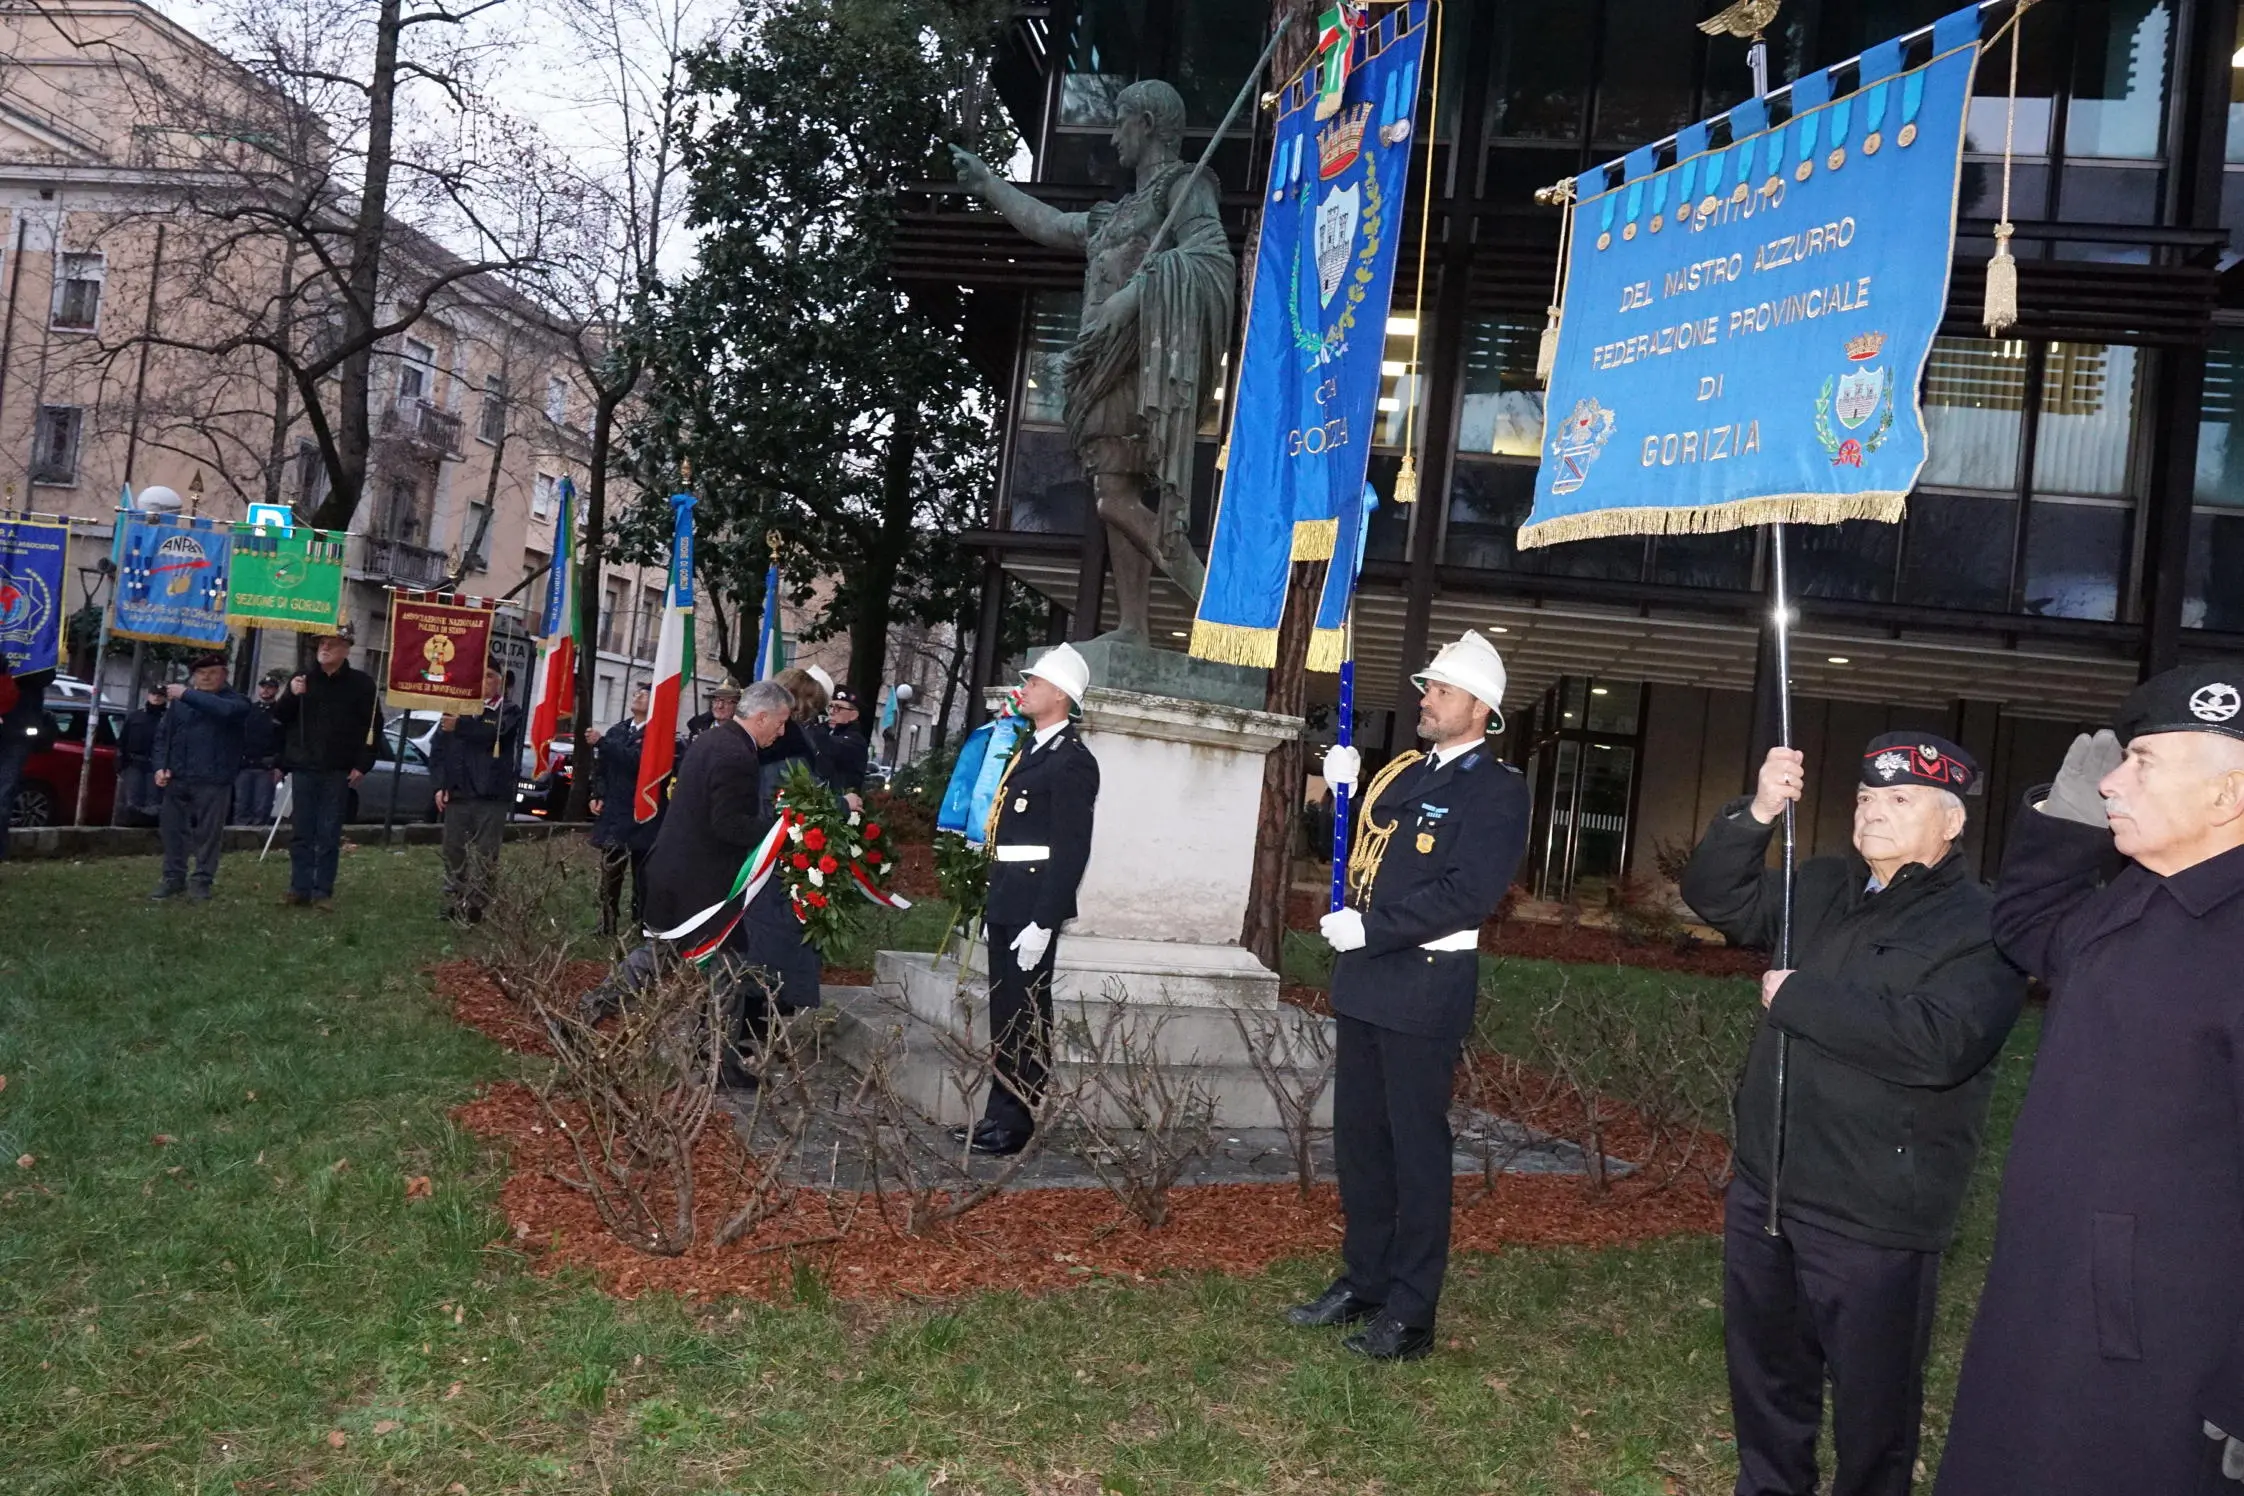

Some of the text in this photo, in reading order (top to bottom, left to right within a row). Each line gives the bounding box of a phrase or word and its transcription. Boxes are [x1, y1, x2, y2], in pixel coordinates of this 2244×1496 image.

[1689, 179, 1786, 235] ISTITUTO
[1619, 216, 1856, 313] DEL NASTRO AZZURRO
[1592, 277, 1871, 371] FEDERAZIONE PROVINCIALE
[1696, 373, 1724, 401] DI
[1640, 419, 1760, 467] GORIZIA
[235, 592, 331, 614] SEZIONE DI GORIZIA
[448, 618, 484, 628] NAZIONALE
